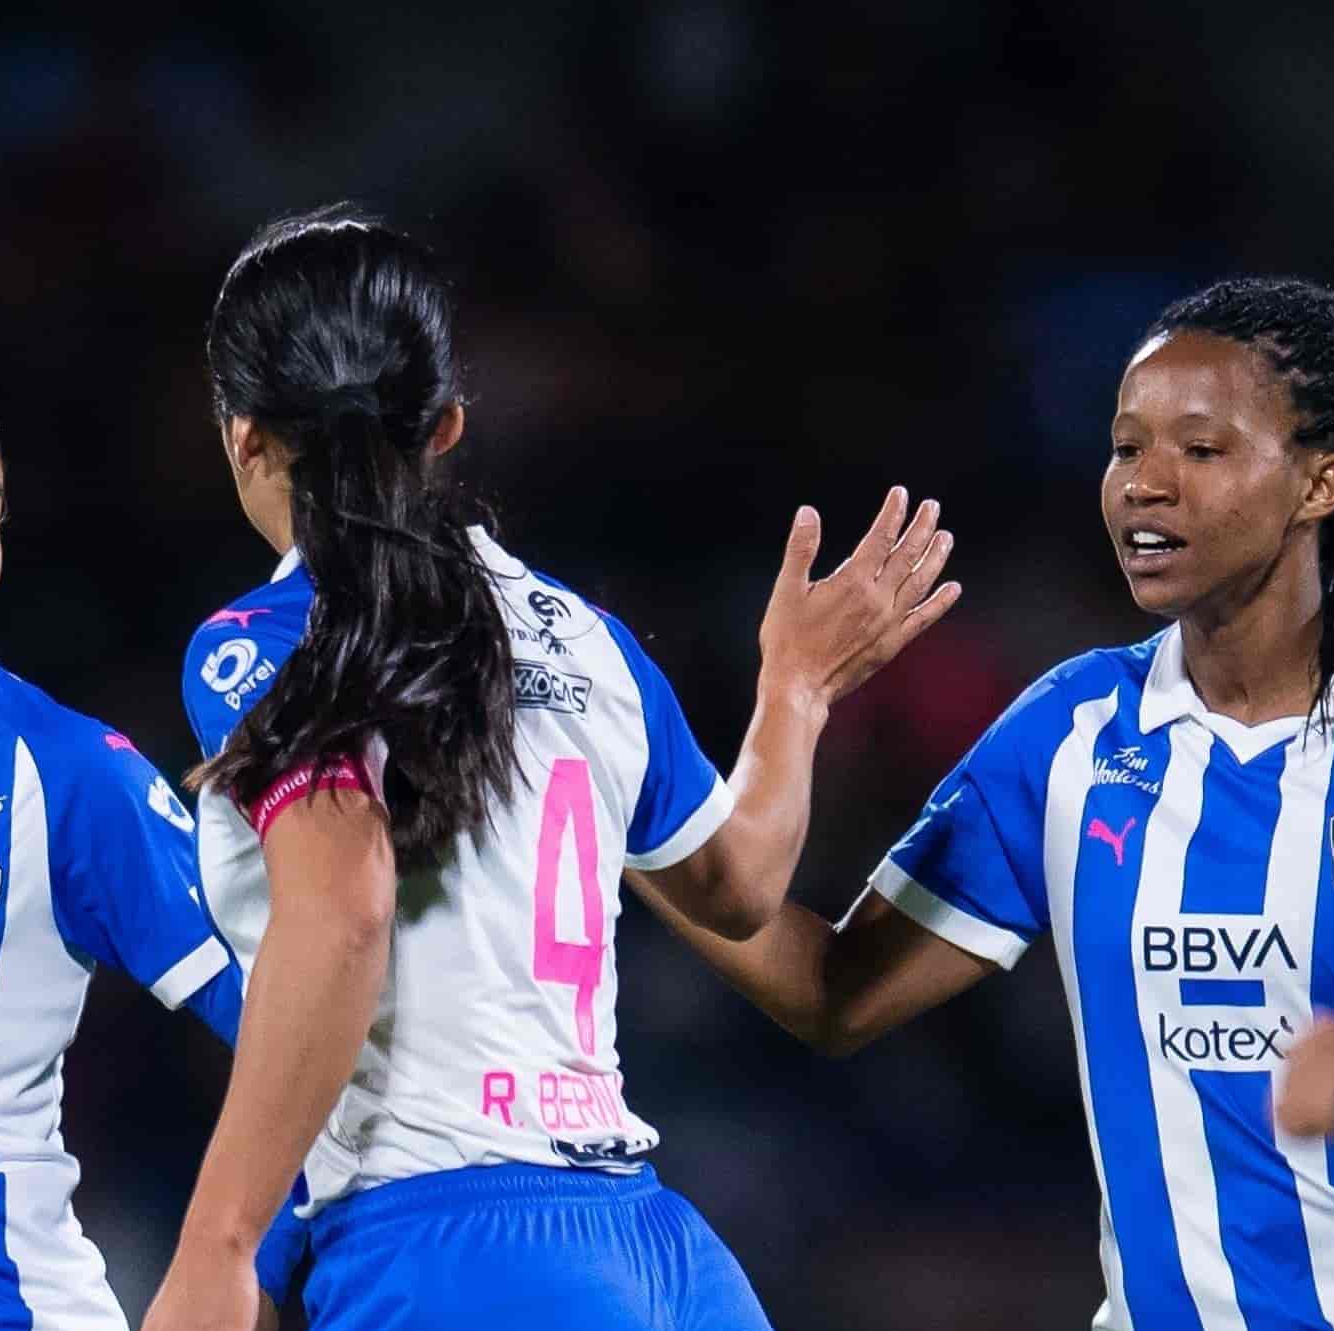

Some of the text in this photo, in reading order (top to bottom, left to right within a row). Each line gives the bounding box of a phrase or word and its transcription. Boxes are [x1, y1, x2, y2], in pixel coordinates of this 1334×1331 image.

[533, 758, 609, 1056] 4
[1143, 923, 1299, 974] BBVA
[1158, 1012, 1285, 1063] kotex
